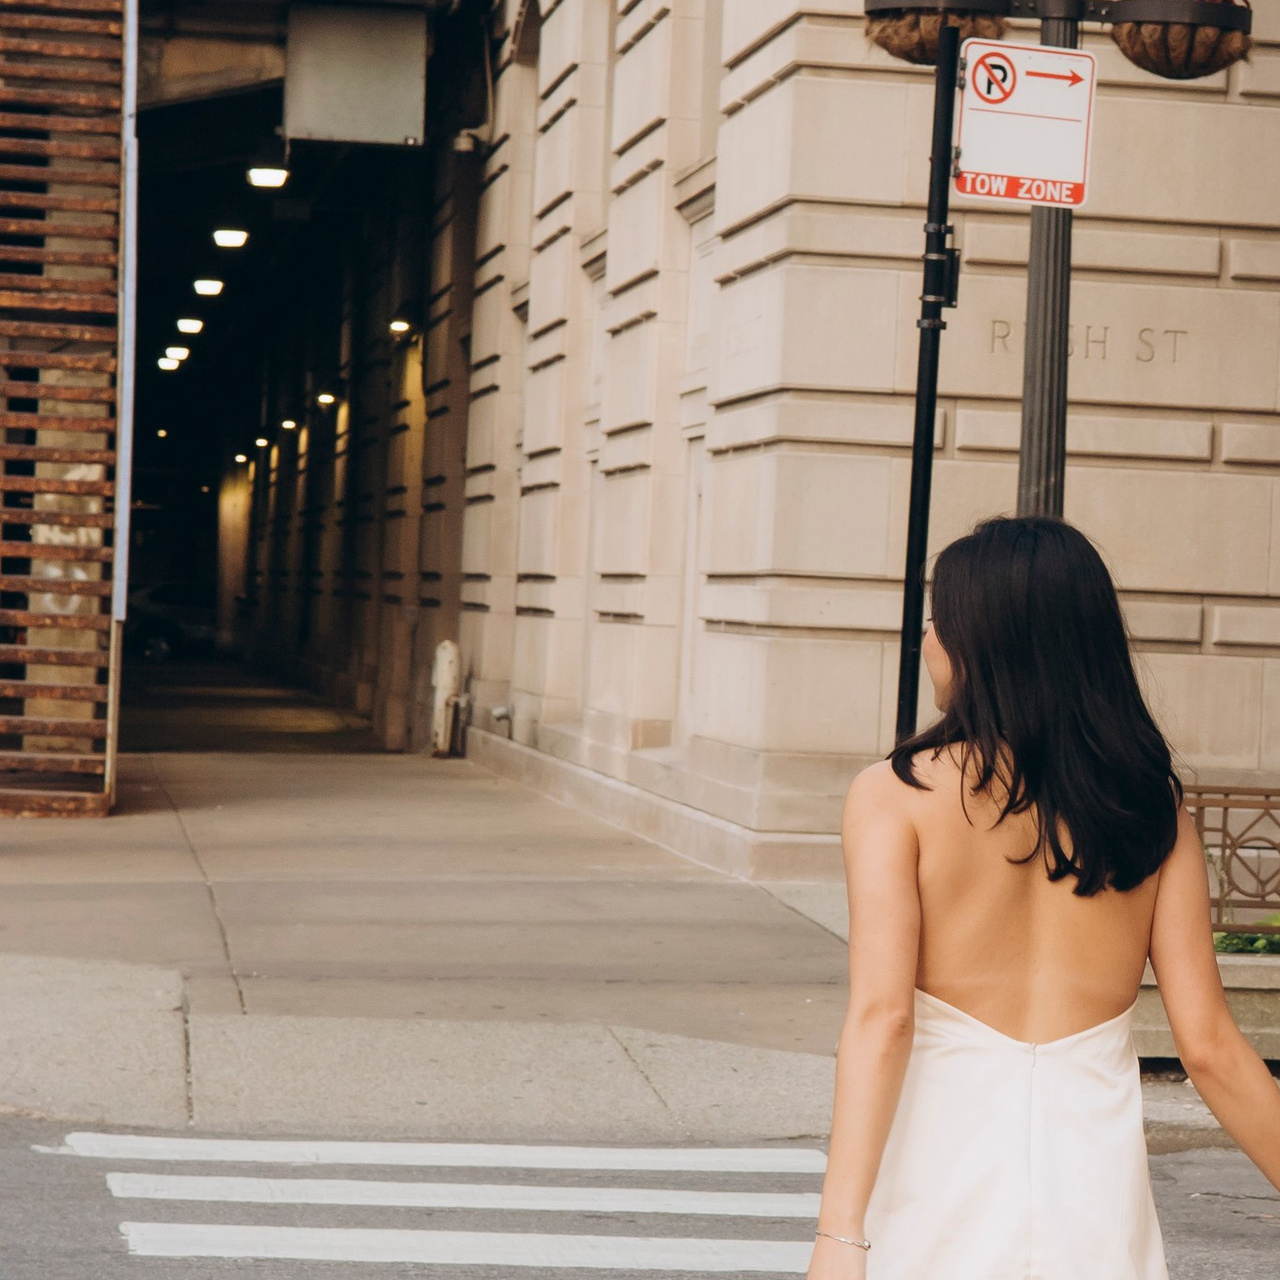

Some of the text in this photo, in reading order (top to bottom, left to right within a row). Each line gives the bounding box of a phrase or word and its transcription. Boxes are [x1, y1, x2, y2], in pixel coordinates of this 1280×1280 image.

[964, 173, 1074, 202] TOW ZONE
[990, 320, 1188, 363] RH ST
